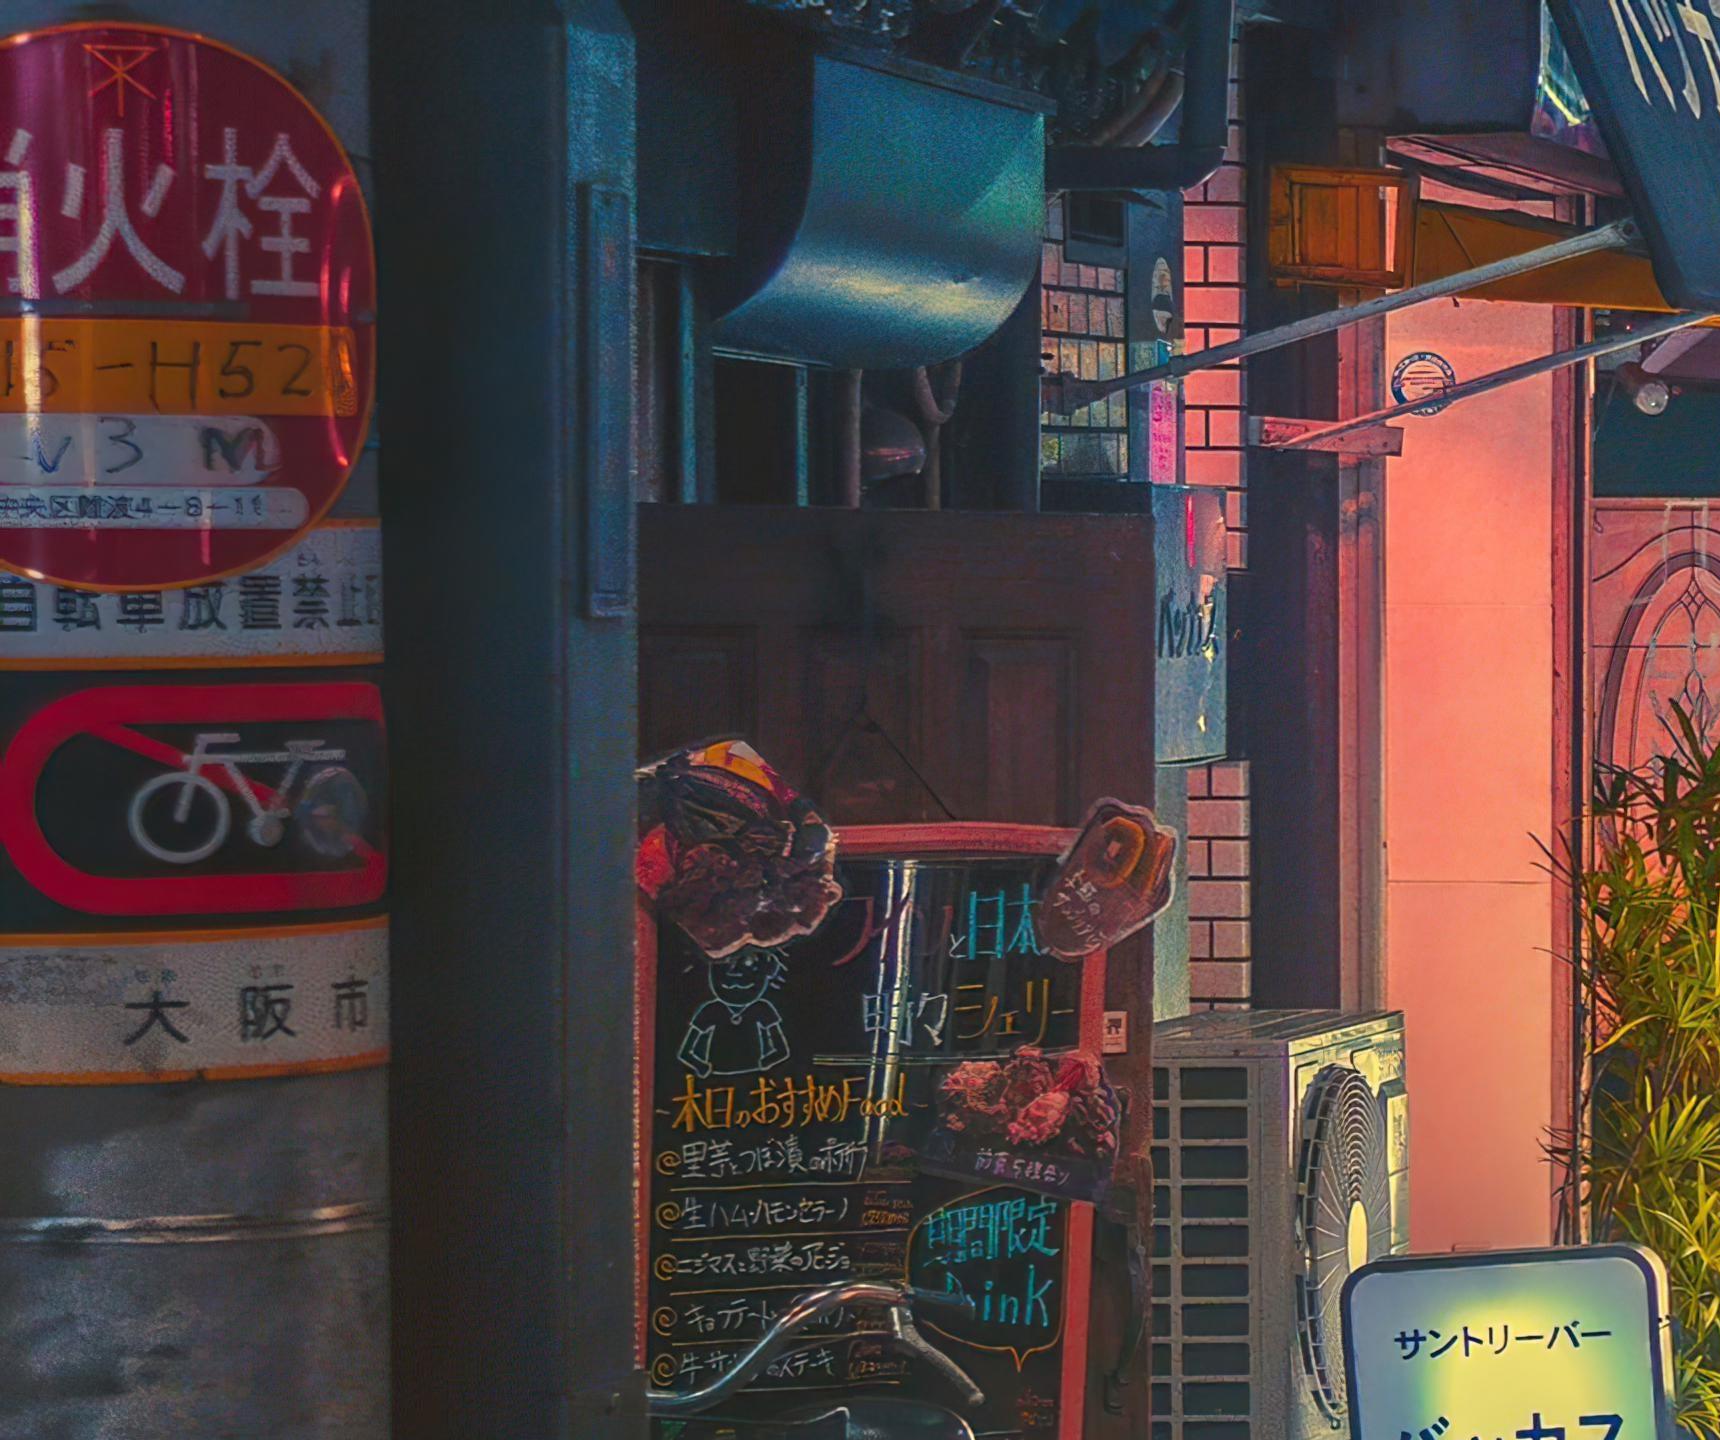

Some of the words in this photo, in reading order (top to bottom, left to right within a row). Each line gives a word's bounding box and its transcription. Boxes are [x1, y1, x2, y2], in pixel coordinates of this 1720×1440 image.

[124, 978, 371, 1046] 大阪市
[1394, 1319, 1612, 1360] サントリーバー
